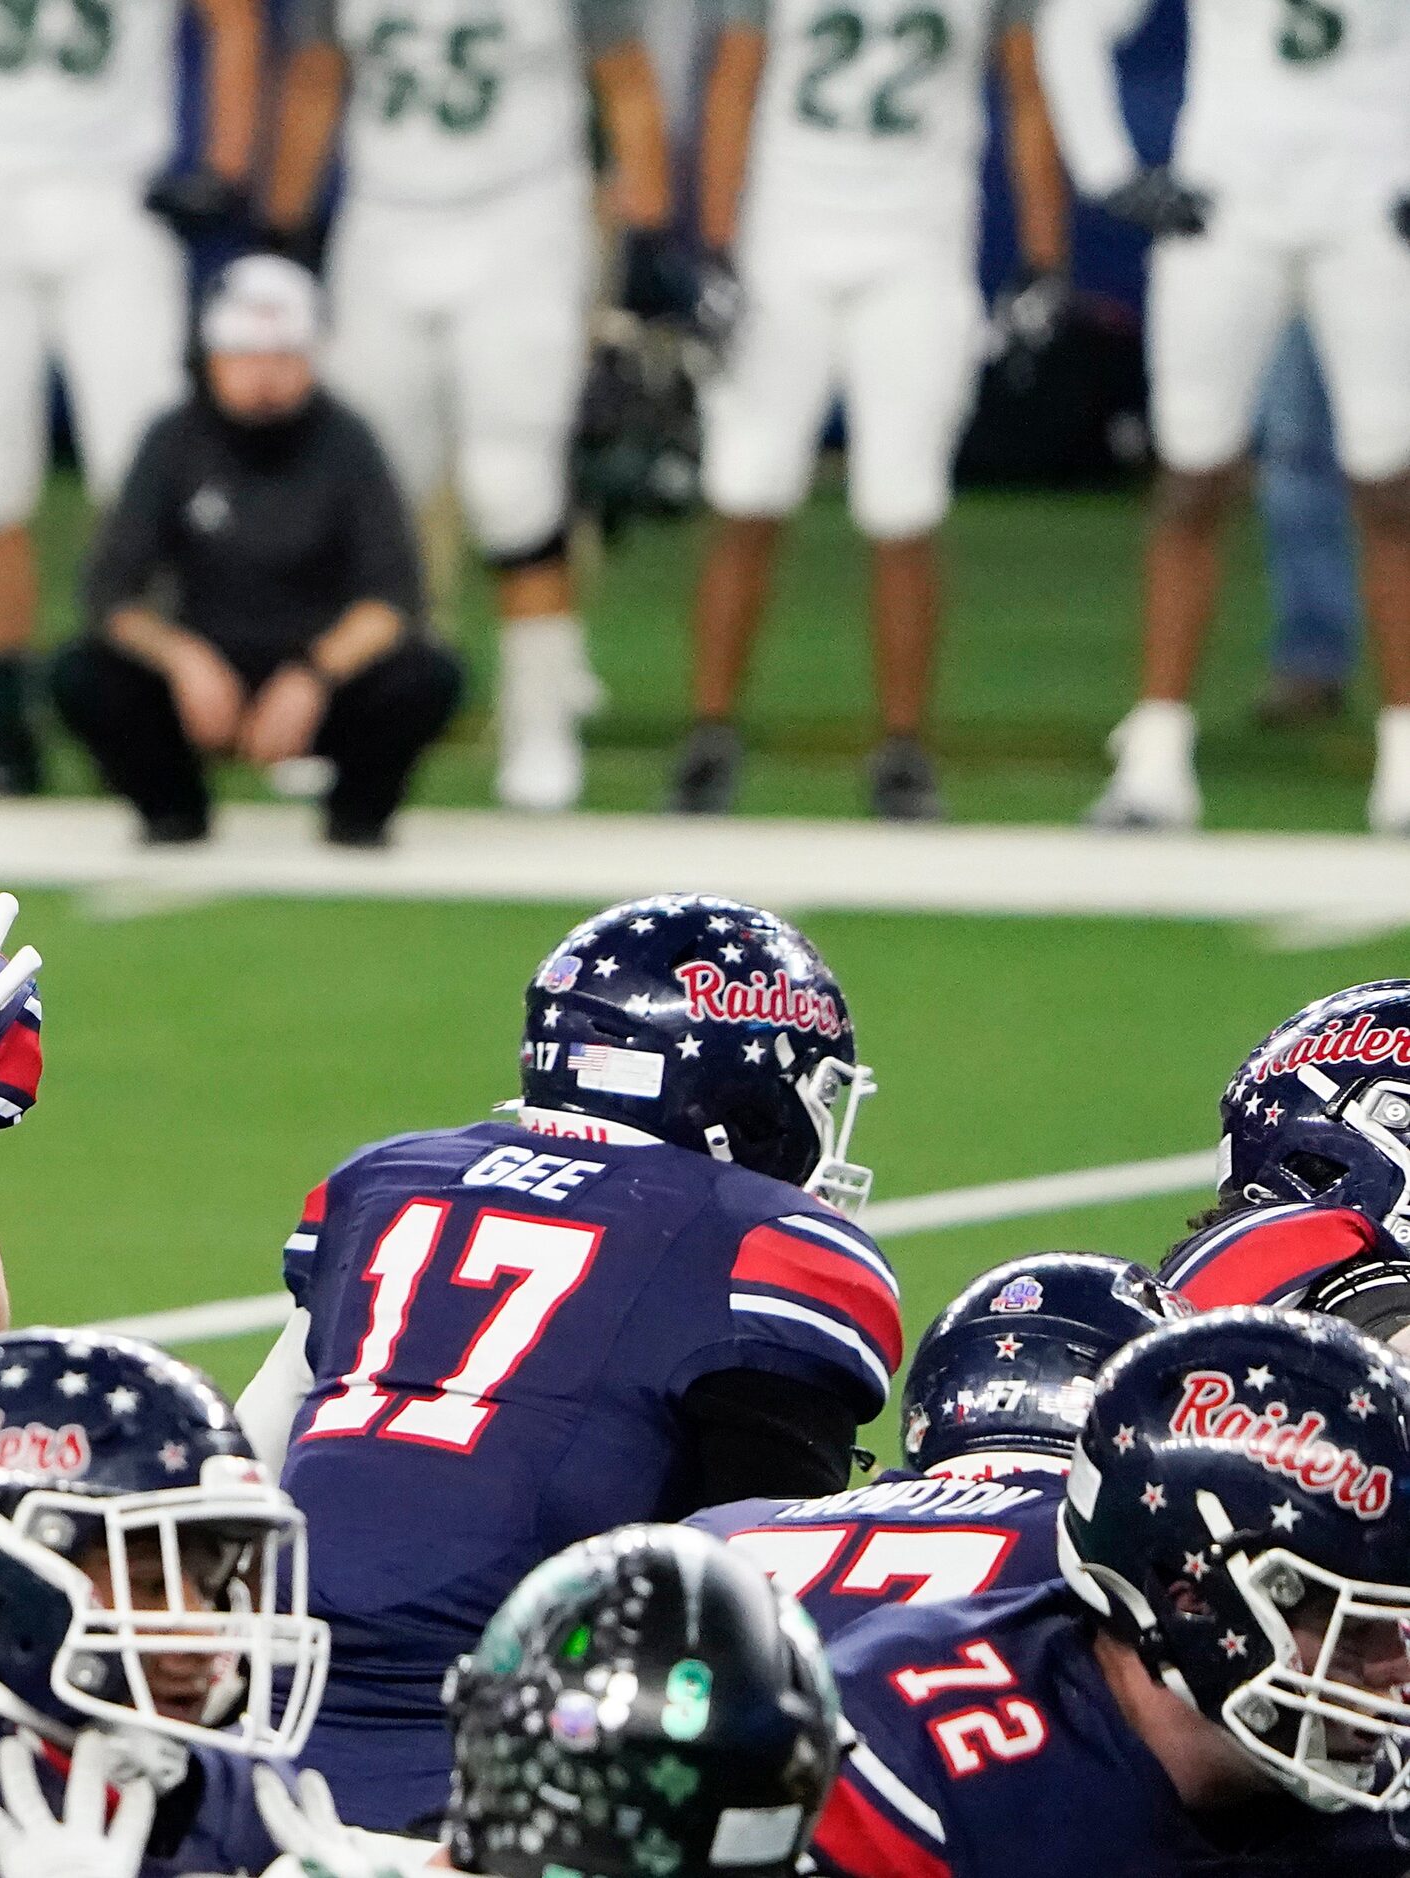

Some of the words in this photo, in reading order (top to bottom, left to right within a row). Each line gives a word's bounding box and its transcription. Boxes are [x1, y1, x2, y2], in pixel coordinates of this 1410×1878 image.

[795, 8, 948, 134] 22
[674, 960, 842, 1040] Raiders
[536, 1041, 560, 1070] 17
[462, 1145, 607, 1201] GEE
[296, 1196, 608, 1455] 17
[985, 1379, 1028, 1412] 77
[1169, 1370, 1394, 1520] Raiders
[889, 1637, 1050, 1782] 72
